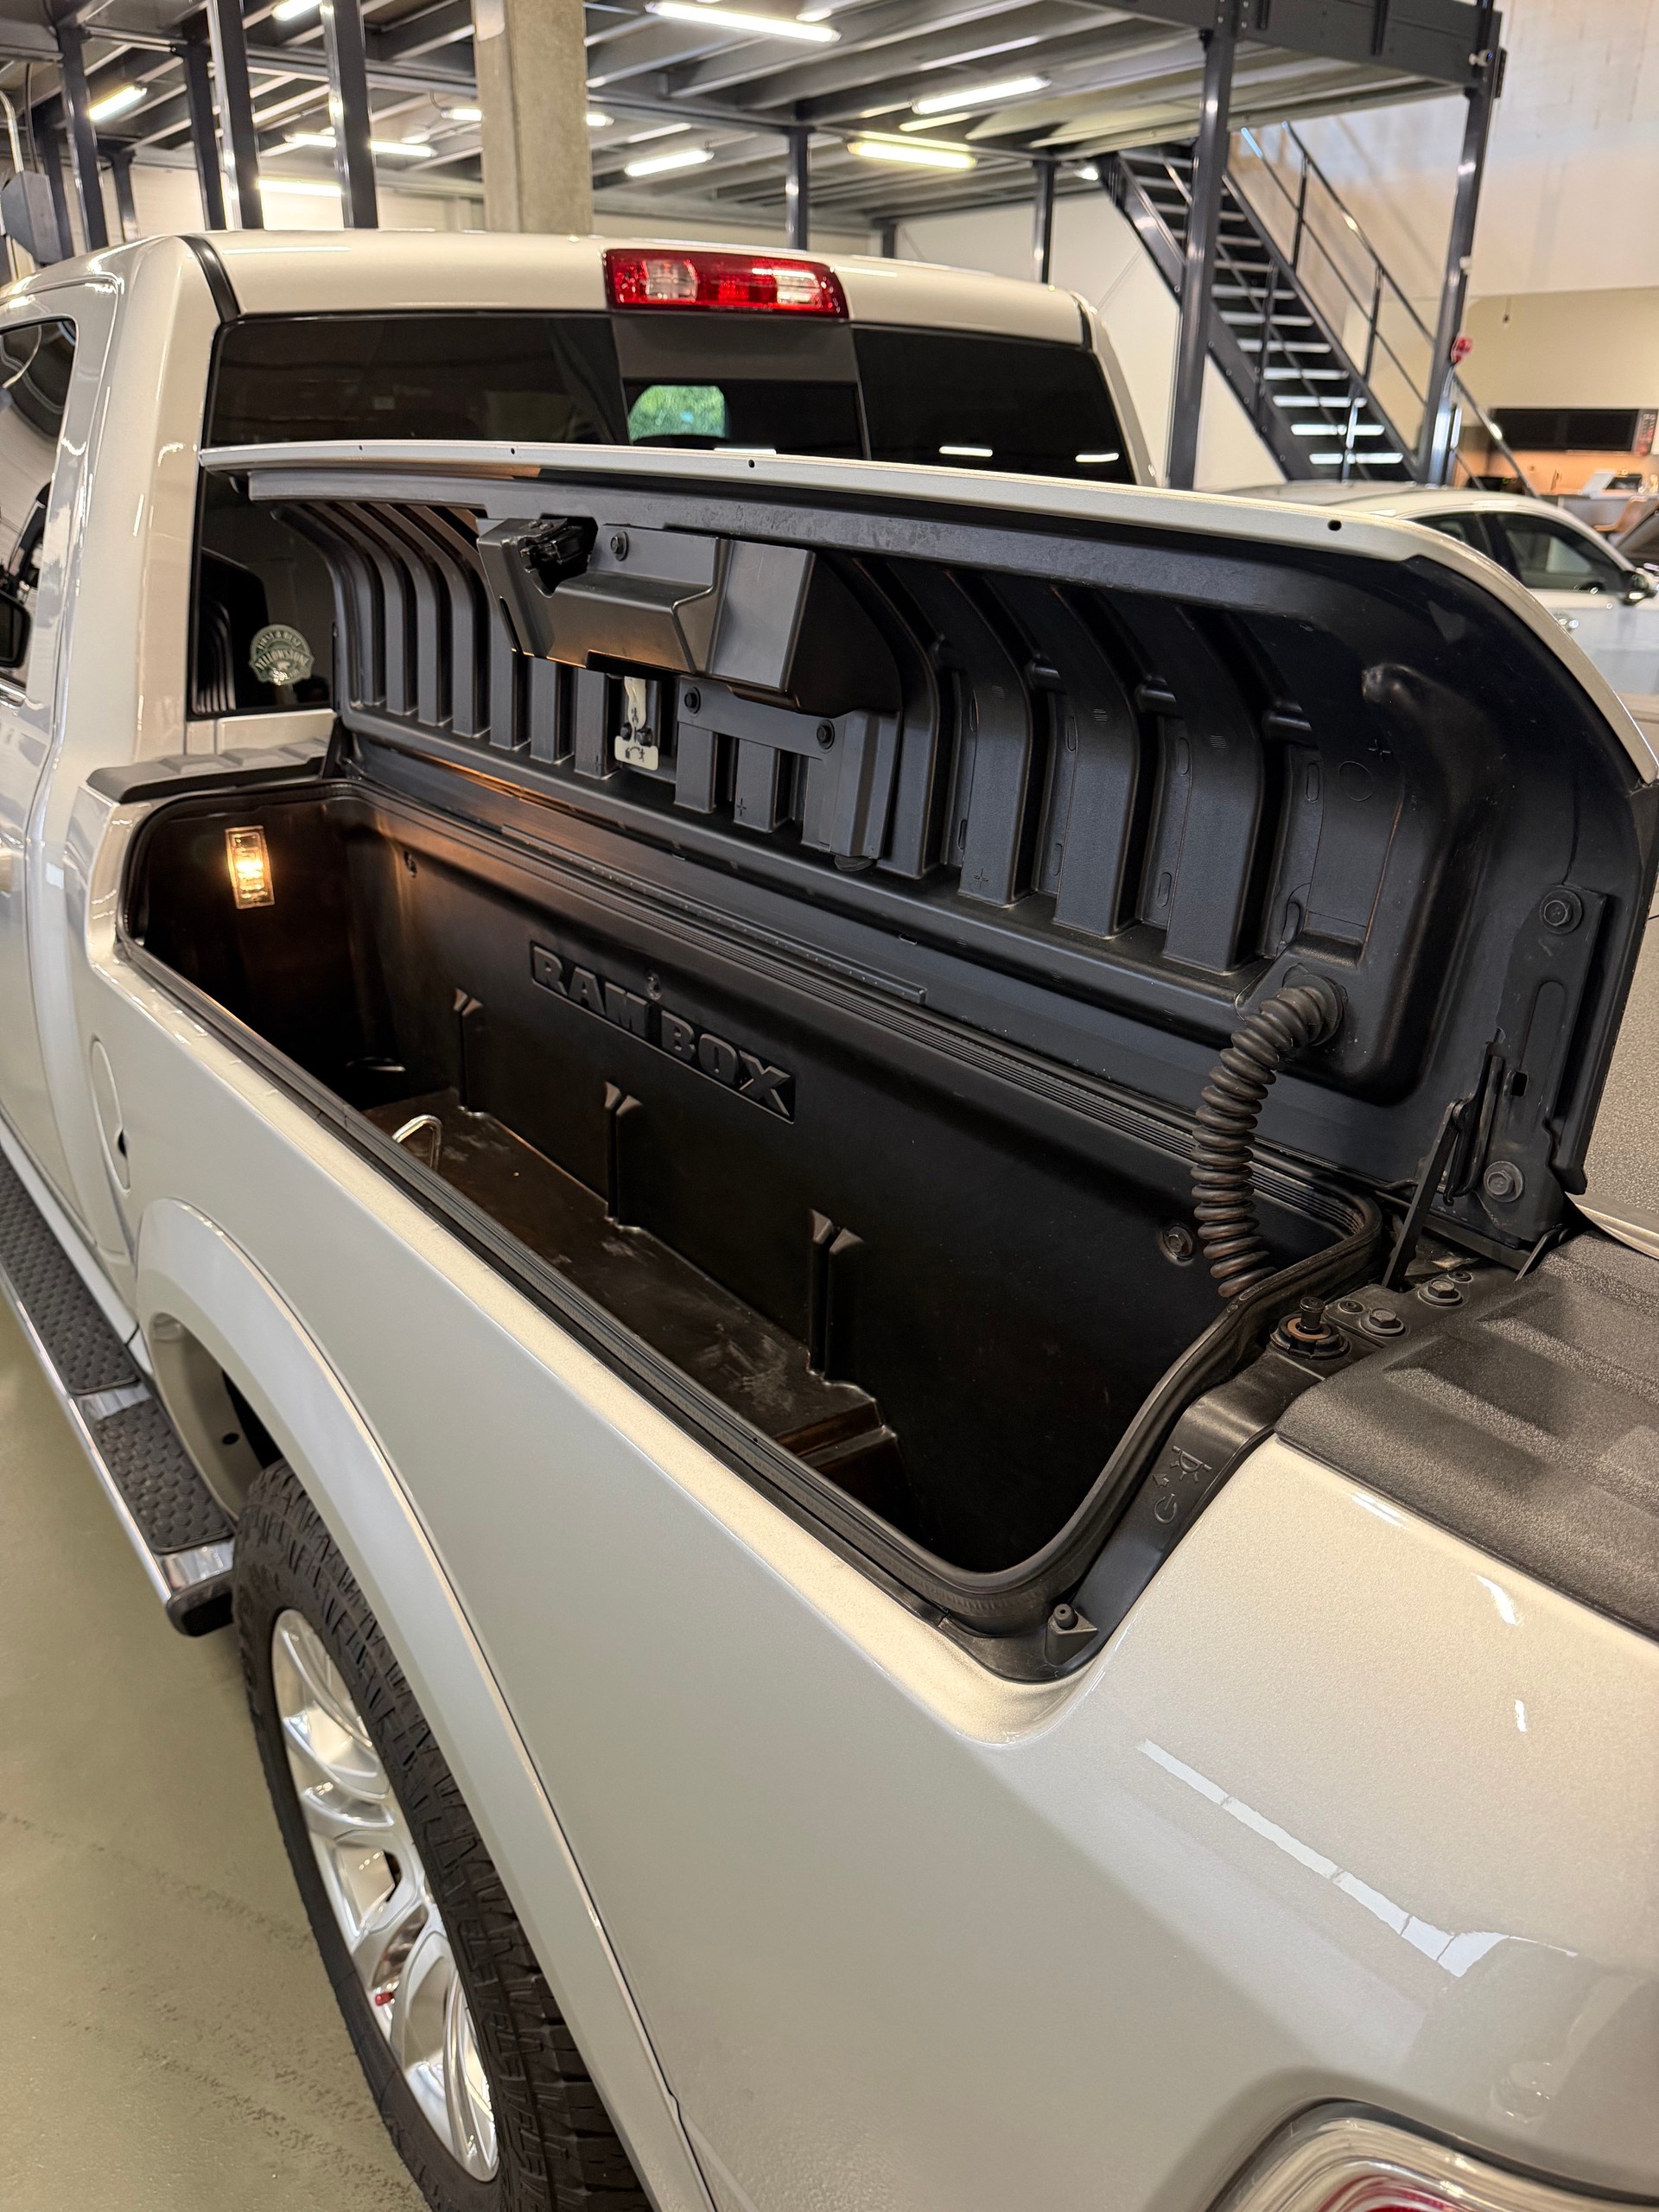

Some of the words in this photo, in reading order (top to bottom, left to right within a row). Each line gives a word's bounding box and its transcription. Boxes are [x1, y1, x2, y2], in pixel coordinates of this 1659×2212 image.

[255, 649, 309, 670] YELLOWSTONE
[533, 945, 648, 1039] RAM
[660, 1009, 791, 1117] BOX
